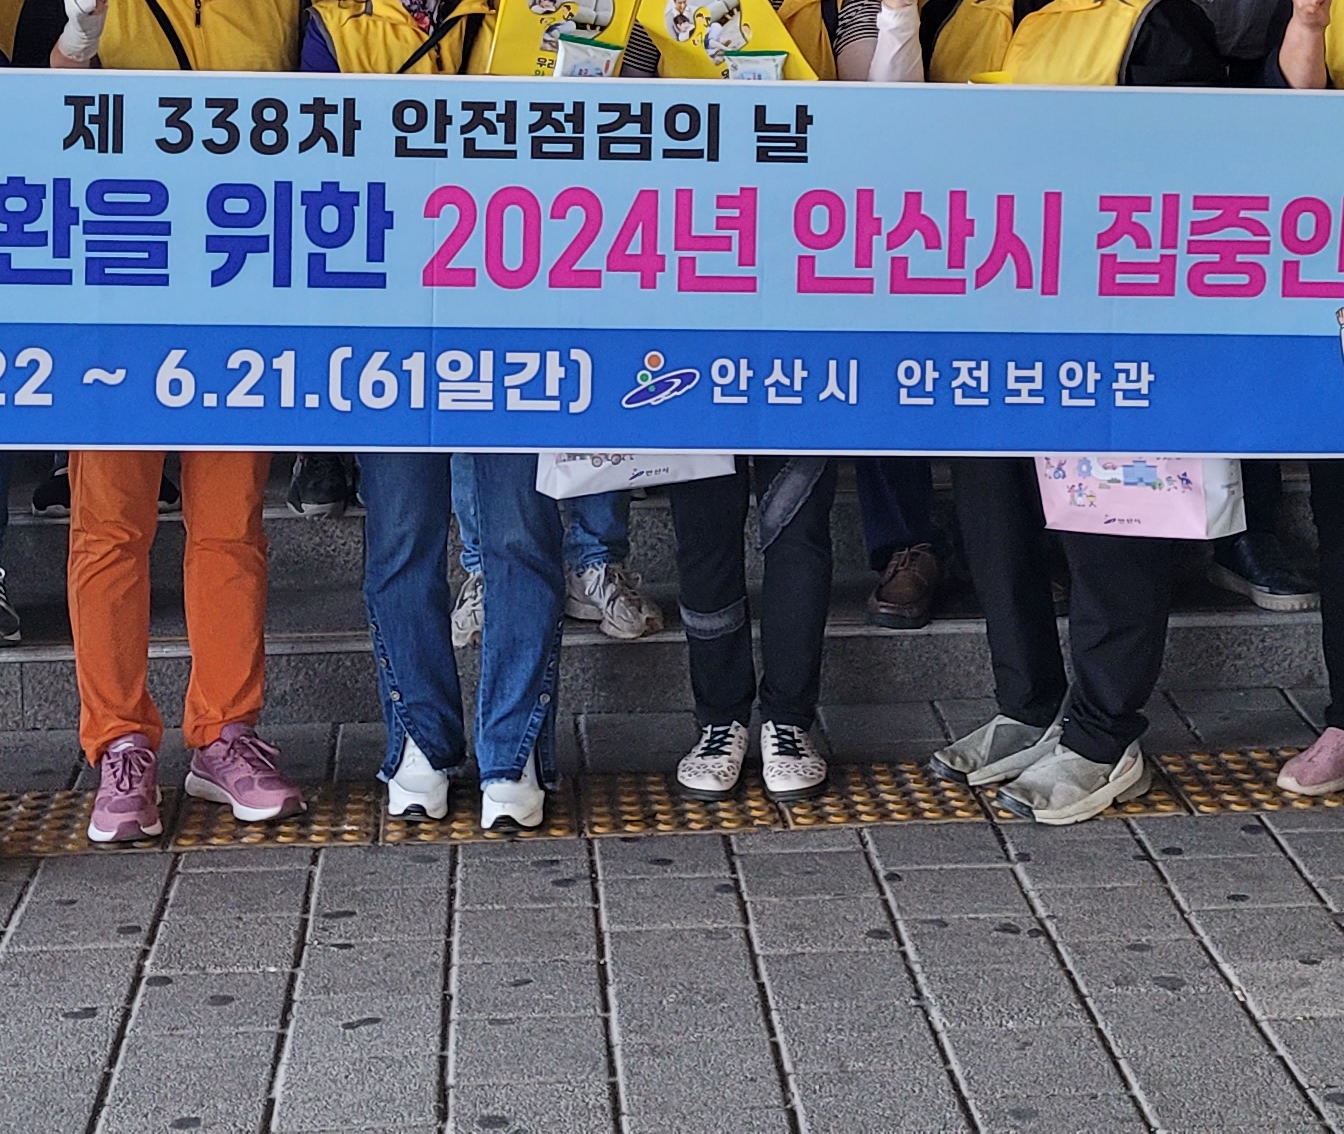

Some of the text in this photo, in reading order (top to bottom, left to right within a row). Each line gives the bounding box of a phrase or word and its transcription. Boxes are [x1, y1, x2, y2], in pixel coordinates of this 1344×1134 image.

[63, 93, 814, 164] 제 338차 안전점검의 날
[205, 180, 394, 289] 위한
[422, 186, 758, 293] 2024년
[793, 189, 1062, 296] 안산시
[156, 346, 593, 414] 6.21.(61일간)
[710, 357, 1156, 408] 안산시 안전보안관
